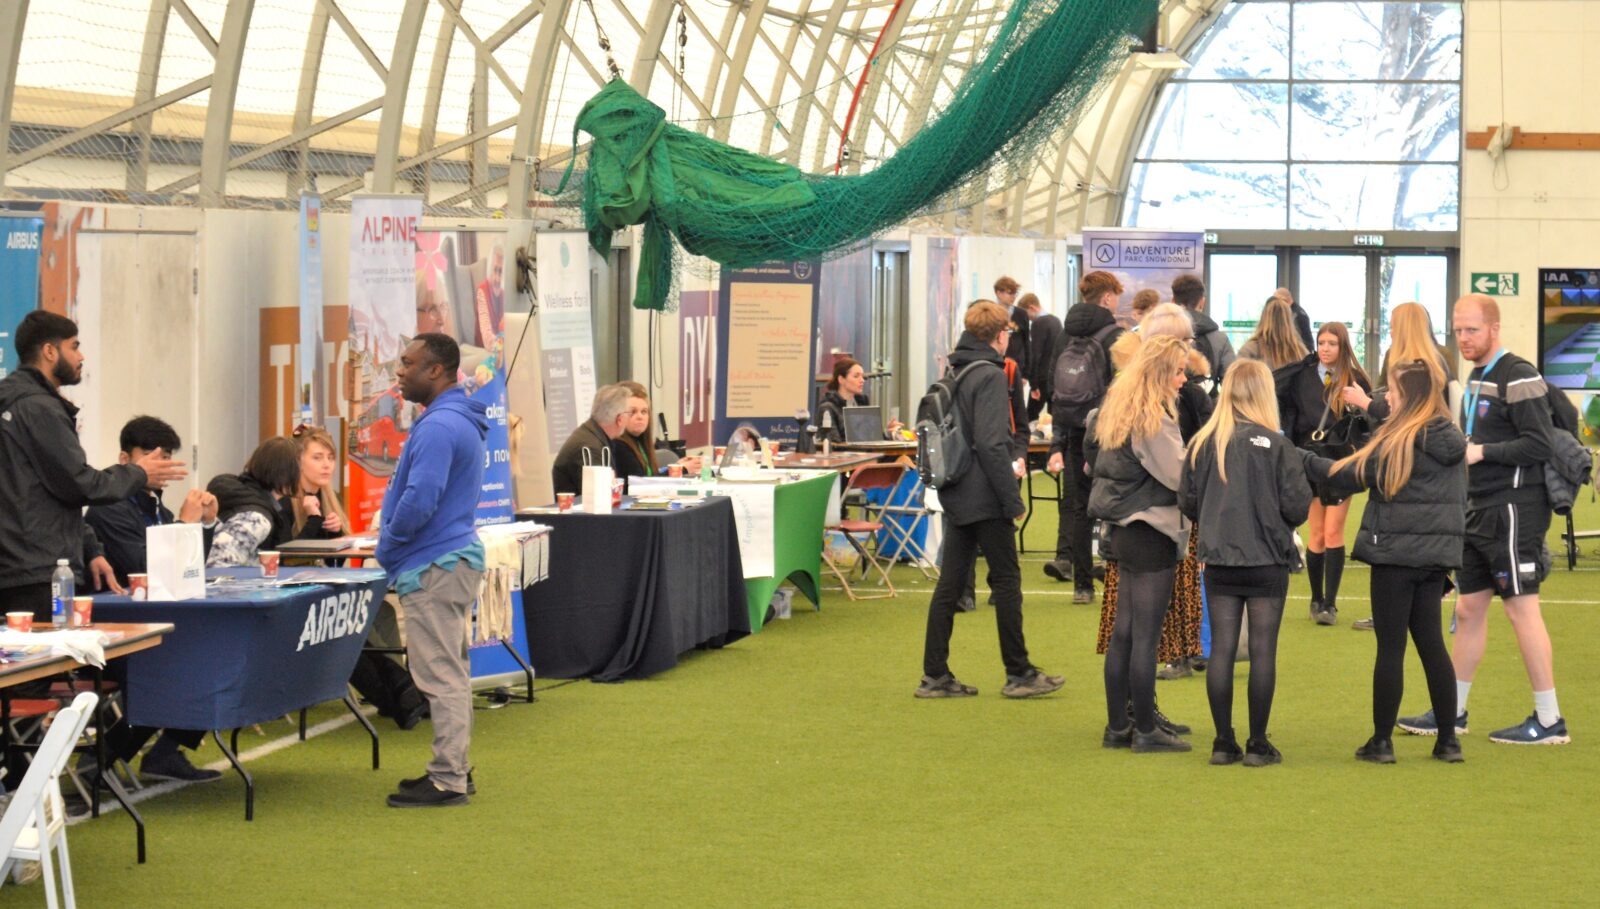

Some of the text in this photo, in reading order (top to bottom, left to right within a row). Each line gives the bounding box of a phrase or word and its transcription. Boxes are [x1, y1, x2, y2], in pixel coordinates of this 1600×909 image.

[362, 216, 417, 242] ALPINE
[7, 232, 38, 249] AIRBUS
[1125, 246, 1190, 256] ADVENTURE
[297, 590, 373, 651] AIRBUS
